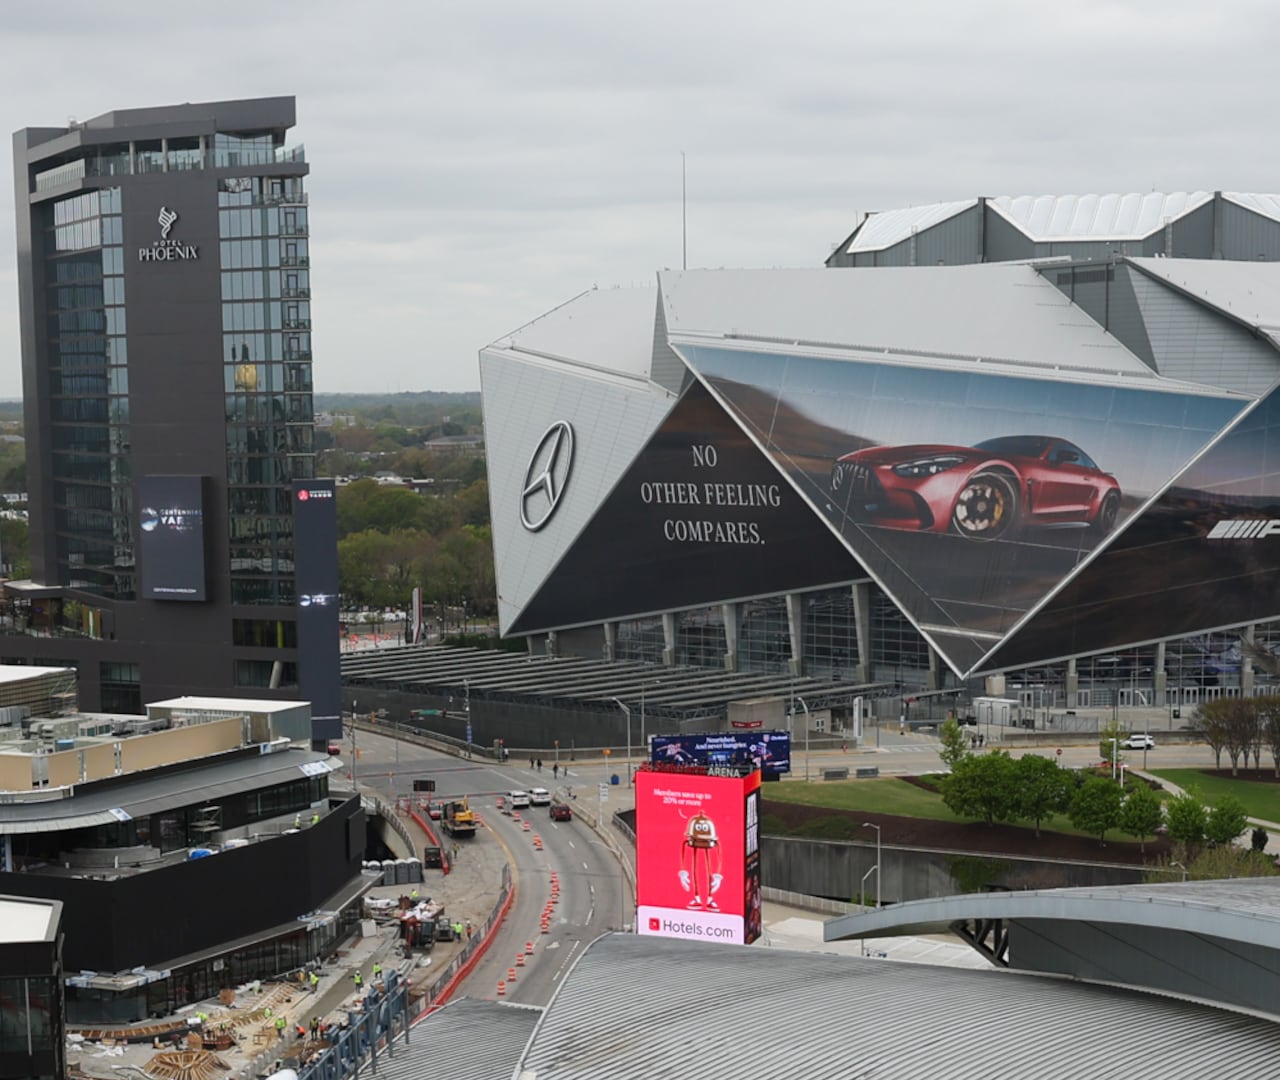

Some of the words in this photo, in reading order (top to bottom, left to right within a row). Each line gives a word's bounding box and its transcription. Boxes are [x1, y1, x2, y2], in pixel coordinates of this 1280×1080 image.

[153, 239, 183, 247] HOTEL
[138, 245, 199, 262] PHOENIX
[692, 444, 717, 467] NO
[640, 481, 701, 505] OTHER
[704, 483, 782, 508] FEELING
[663, 519, 765, 544] COMPARES.
[707, 767, 741, 778] ARENA
[663, 919, 733, 939] Hotels.com
